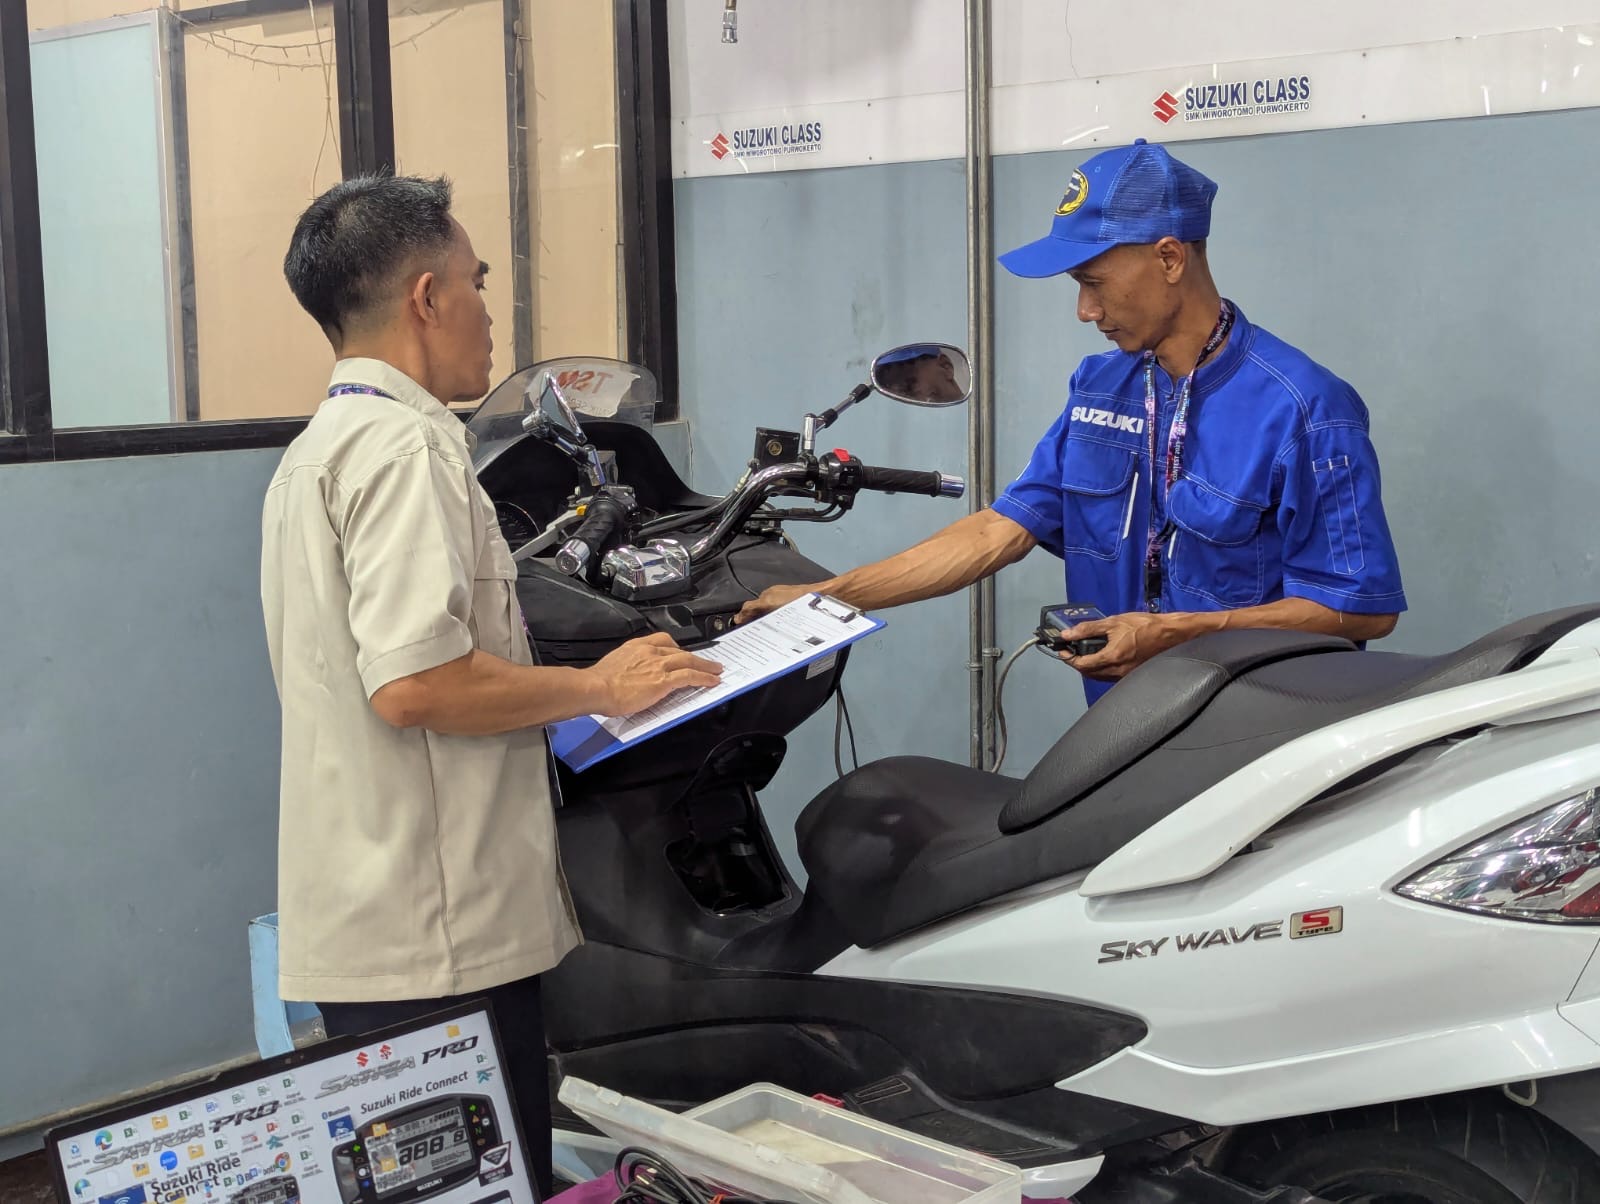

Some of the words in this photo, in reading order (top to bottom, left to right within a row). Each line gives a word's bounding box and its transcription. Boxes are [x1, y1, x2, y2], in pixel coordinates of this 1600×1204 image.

[1185, 82, 1247, 111] SUZUKI
[1253, 76, 1310, 104] CLASS
[1185, 112, 1201, 121] SMK
[1202, 107, 1254, 119] WIWOROTOMO
[1256, 102, 1310, 114] PURWOKERTO
[733, 127, 777, 150] SUZUKI
[781, 122, 822, 145] CLASS
[783, 144, 822, 154] PURWOKERTO
[1070, 406, 1145, 434] SUZUKI
[1300, 909, 1331, 930] S
[1097, 936, 1170, 964] SKY
[1175, 919, 1284, 953] WAVE
[422, 1035, 479, 1064] PRO
[360, 1094, 397, 1115] Suzuki
[399, 1086, 423, 1102] Ride
[425, 1071, 469, 1093] Connect
[208, 1100, 282, 1134] PRO
[151, 1167, 204, 1195] Suzuki
[206, 1155, 242, 1177] Ride
